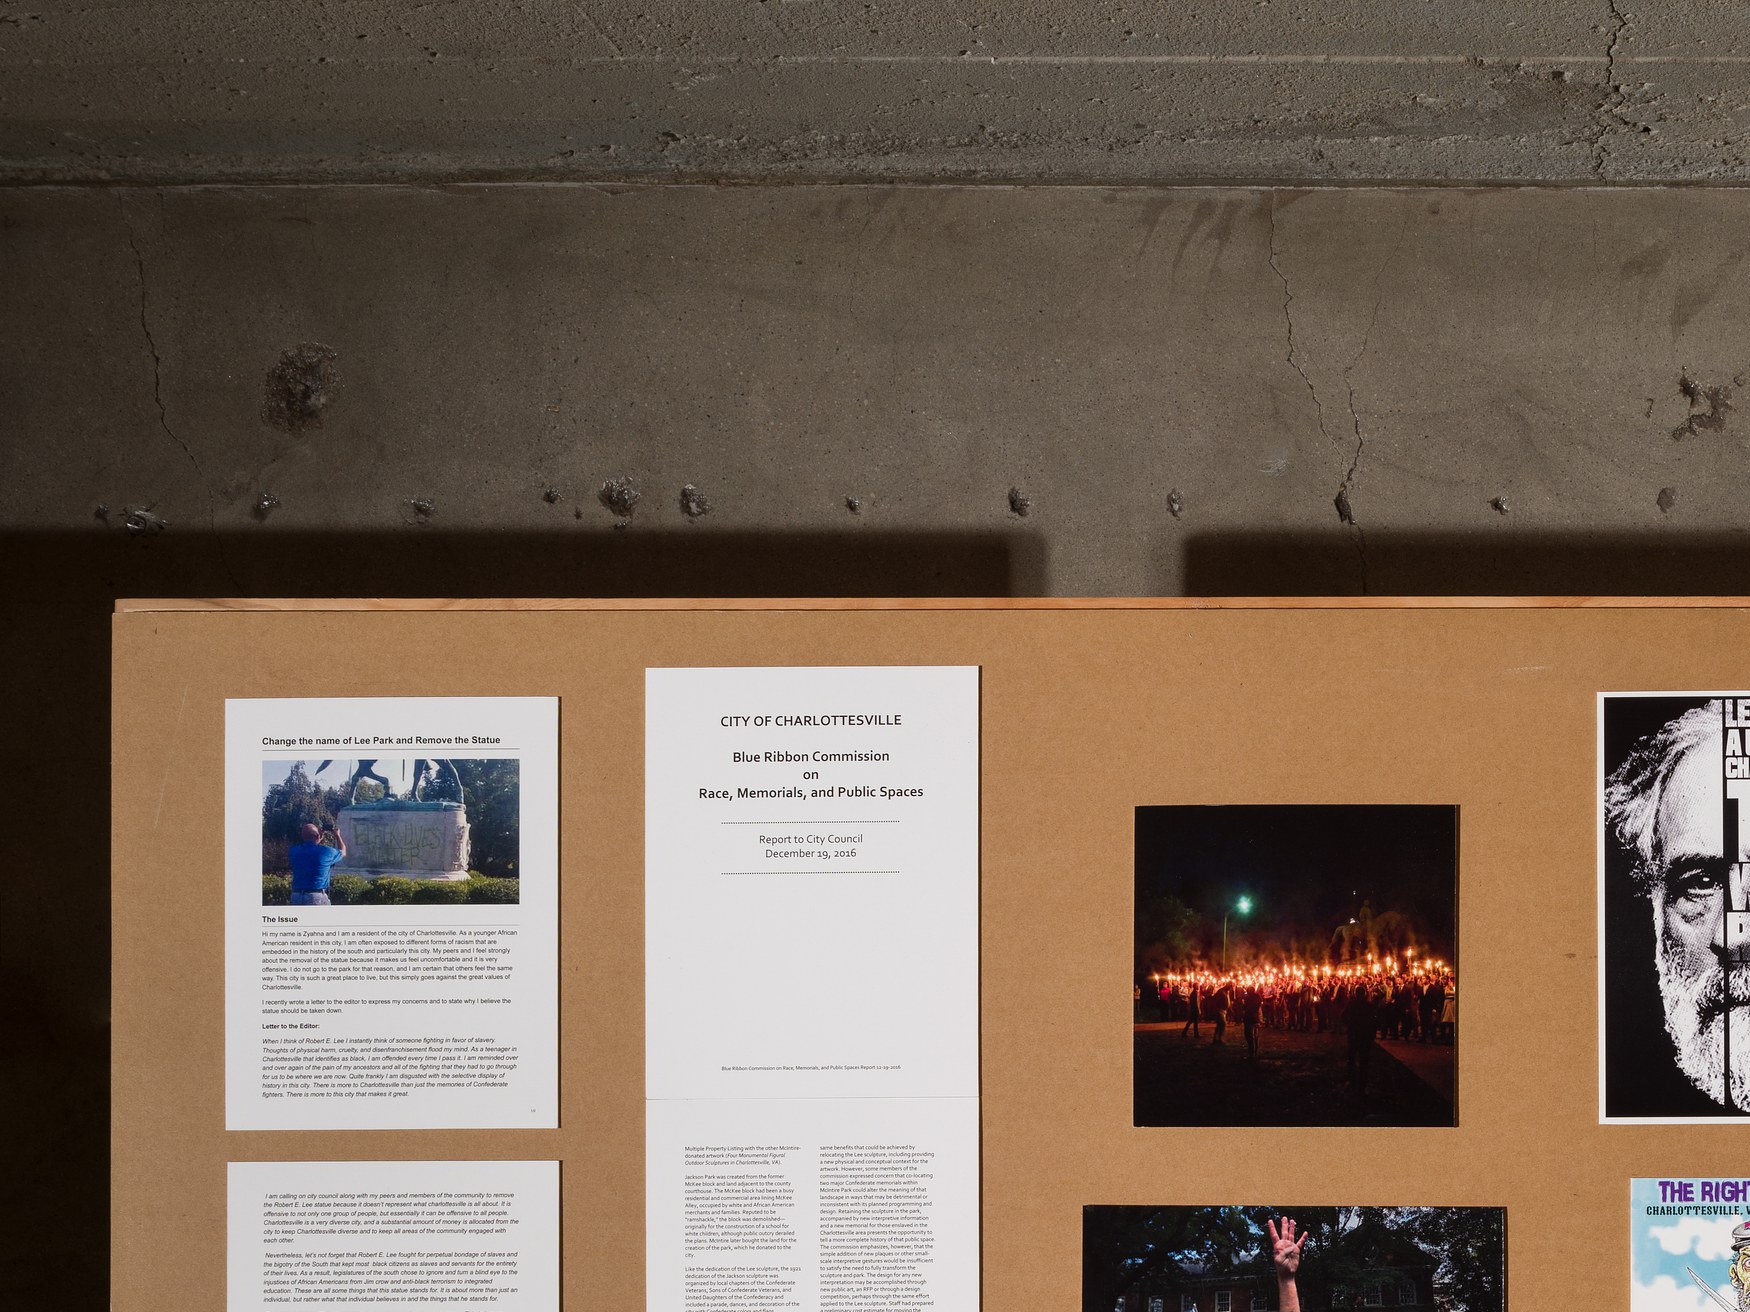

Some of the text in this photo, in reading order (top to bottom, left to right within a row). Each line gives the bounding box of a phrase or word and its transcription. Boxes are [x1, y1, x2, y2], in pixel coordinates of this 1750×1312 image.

[721, 715, 902, 727] CITY OF CHARLOTTESVILLE
[262, 735, 501, 747] Change the name of Lee Park and Remove the Statue
[733, 750, 889, 763] Blue Ribbon Commission
[803, 771, 819, 780] on
[699, 786, 923, 801] Race, Memorials, and Public Spaces
[759, 834, 863, 846] Report to City Council
[765, 848, 857, 860] December 19, 2016
[262, 915, 298, 924] The Issue
[1658, 1181, 1695, 1203] THE
